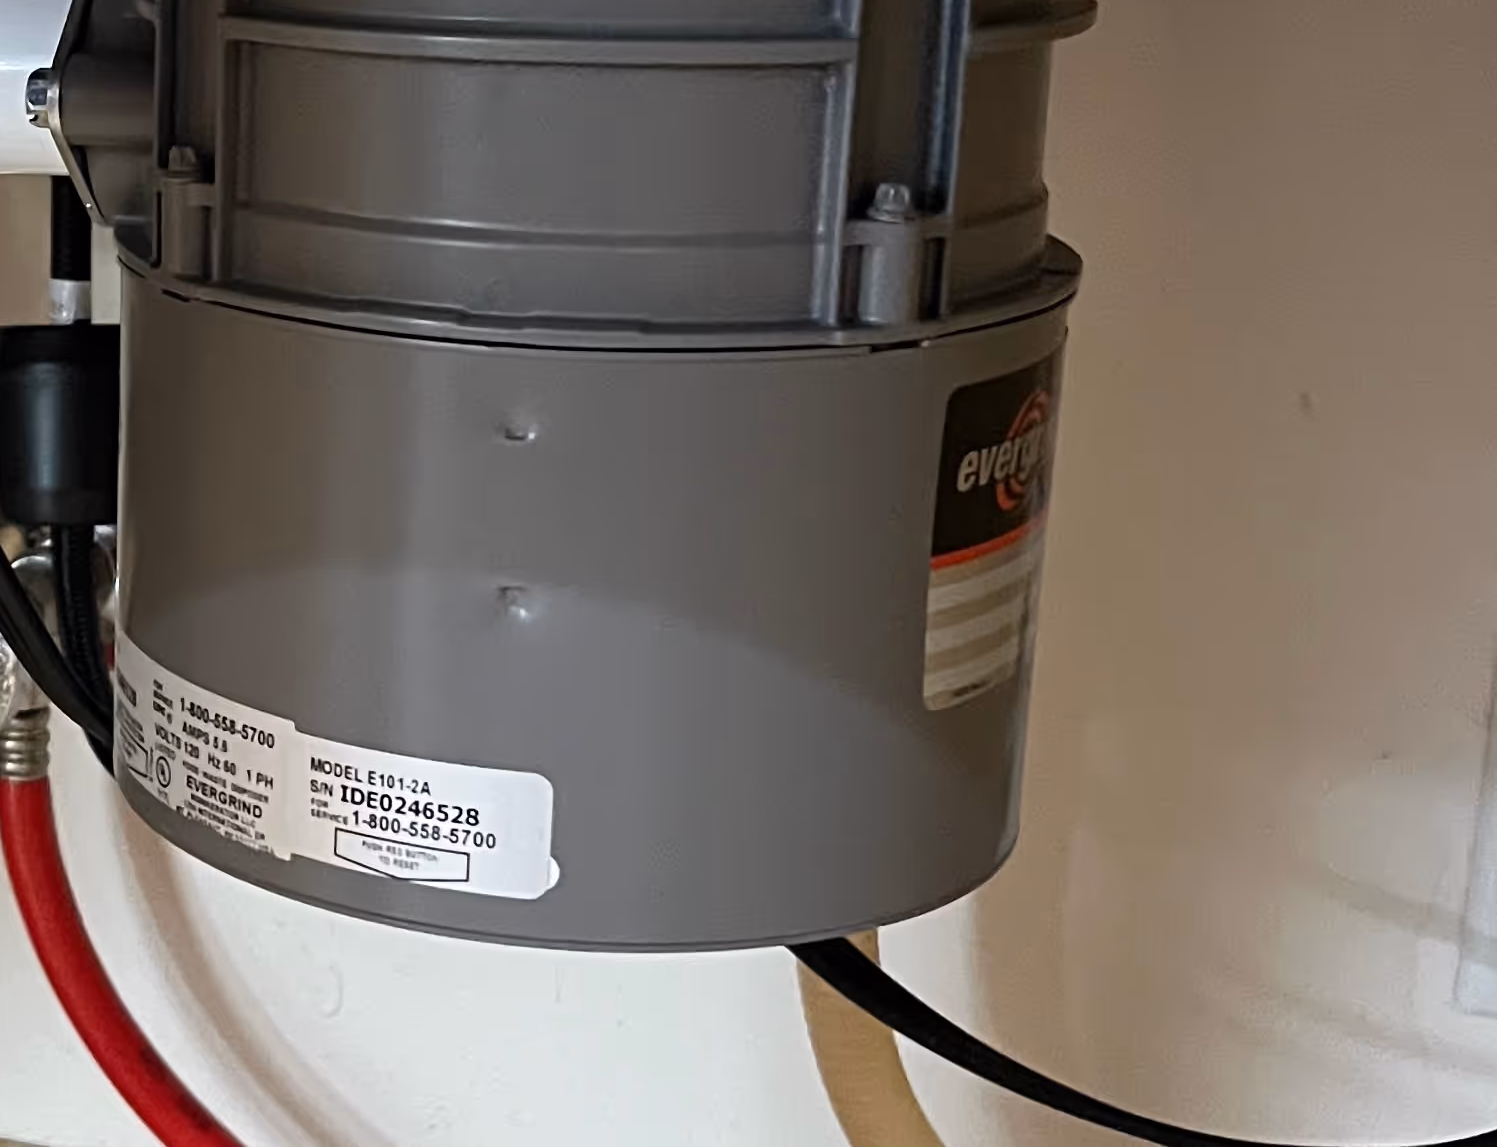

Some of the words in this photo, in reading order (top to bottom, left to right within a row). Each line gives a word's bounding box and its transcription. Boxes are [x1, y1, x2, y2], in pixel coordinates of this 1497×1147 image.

[180, 697, 275, 749] 1-800-558-5700
[182, 721, 209, 745] AMPS
[154, 724, 182, 750] VOLTS
[184, 741, 199, 759] 120
[207, 752, 221, 770] Hz
[256, 772, 274, 790] PH
[309, 756, 363, 783] MODEL
[367, 770, 432, 796] E101-2A
[186, 774, 263, 819] EVERGRIND
[309, 779, 334, 797] S/N
[340, 784, 480, 827] IDE0246528
[351, 810, 497, 850] 1-800-558-5700
